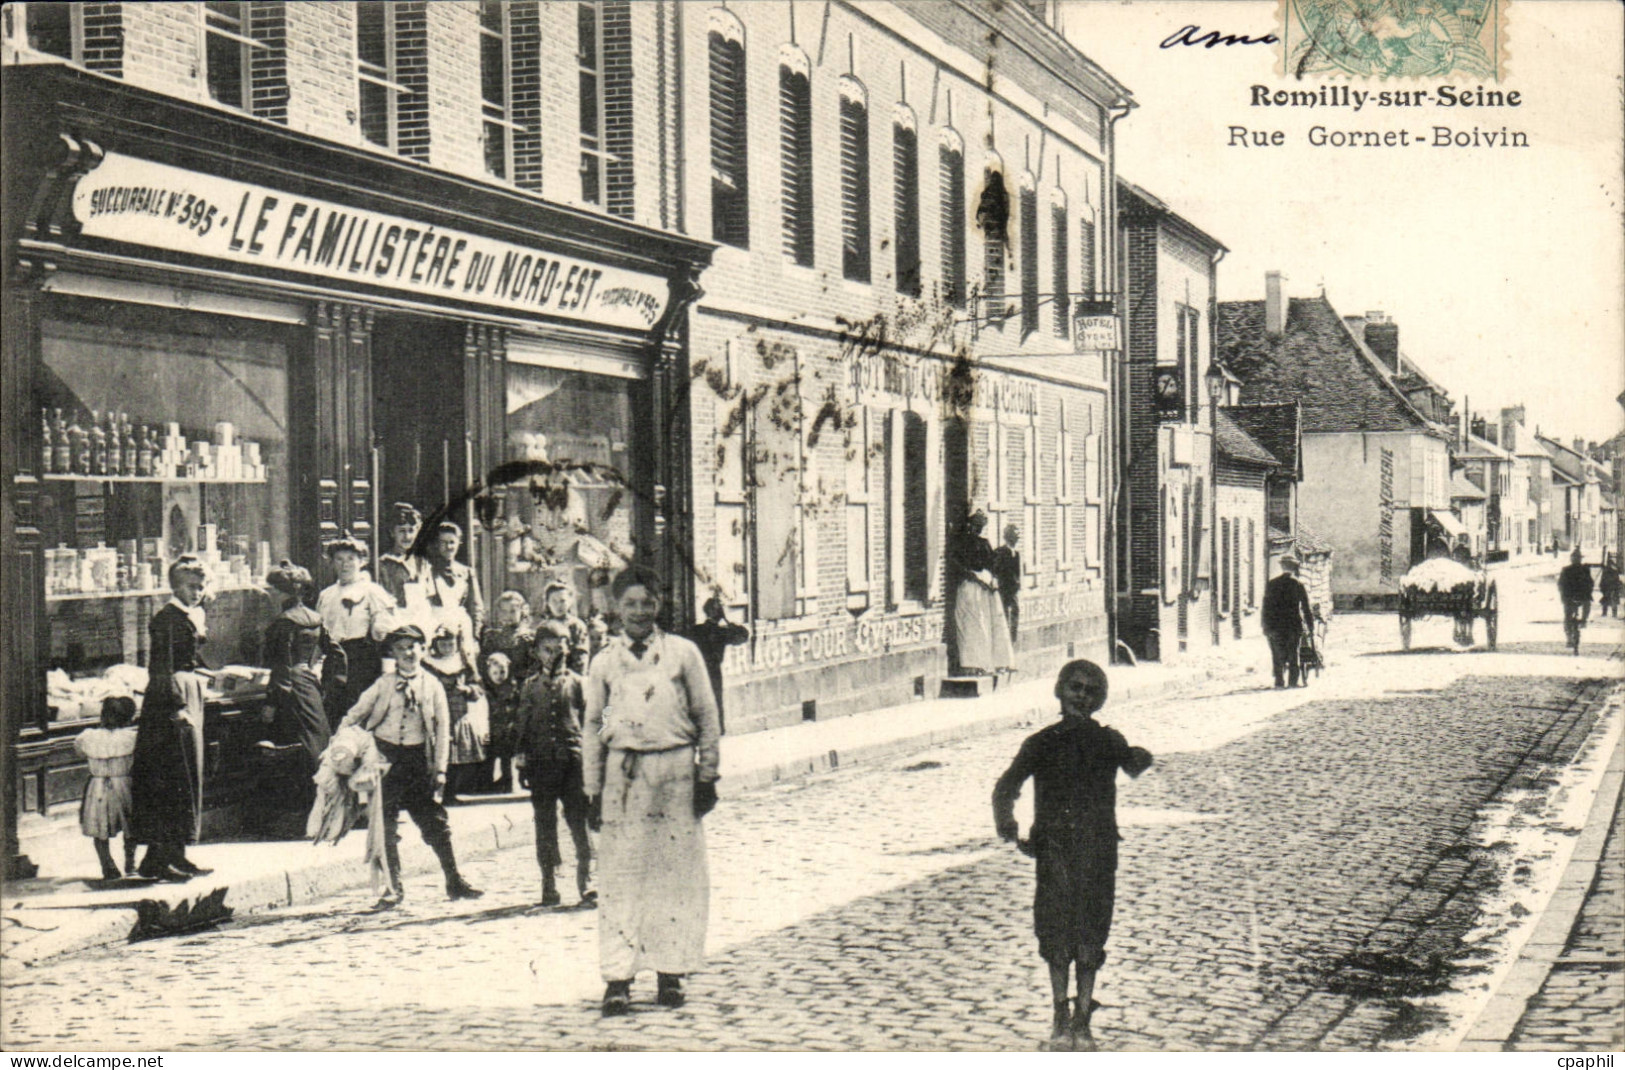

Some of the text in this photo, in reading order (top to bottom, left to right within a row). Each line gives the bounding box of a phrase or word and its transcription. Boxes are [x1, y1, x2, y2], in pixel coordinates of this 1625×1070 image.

[90, 186, 167, 217] SUCCURSALE
[177, 193, 218, 237] 395
[229, 191, 279, 254] LE
[464, 251, 496, 294] DU
[799, 626, 848, 663] POUR
[855, 614, 923, 652] CYCLES
